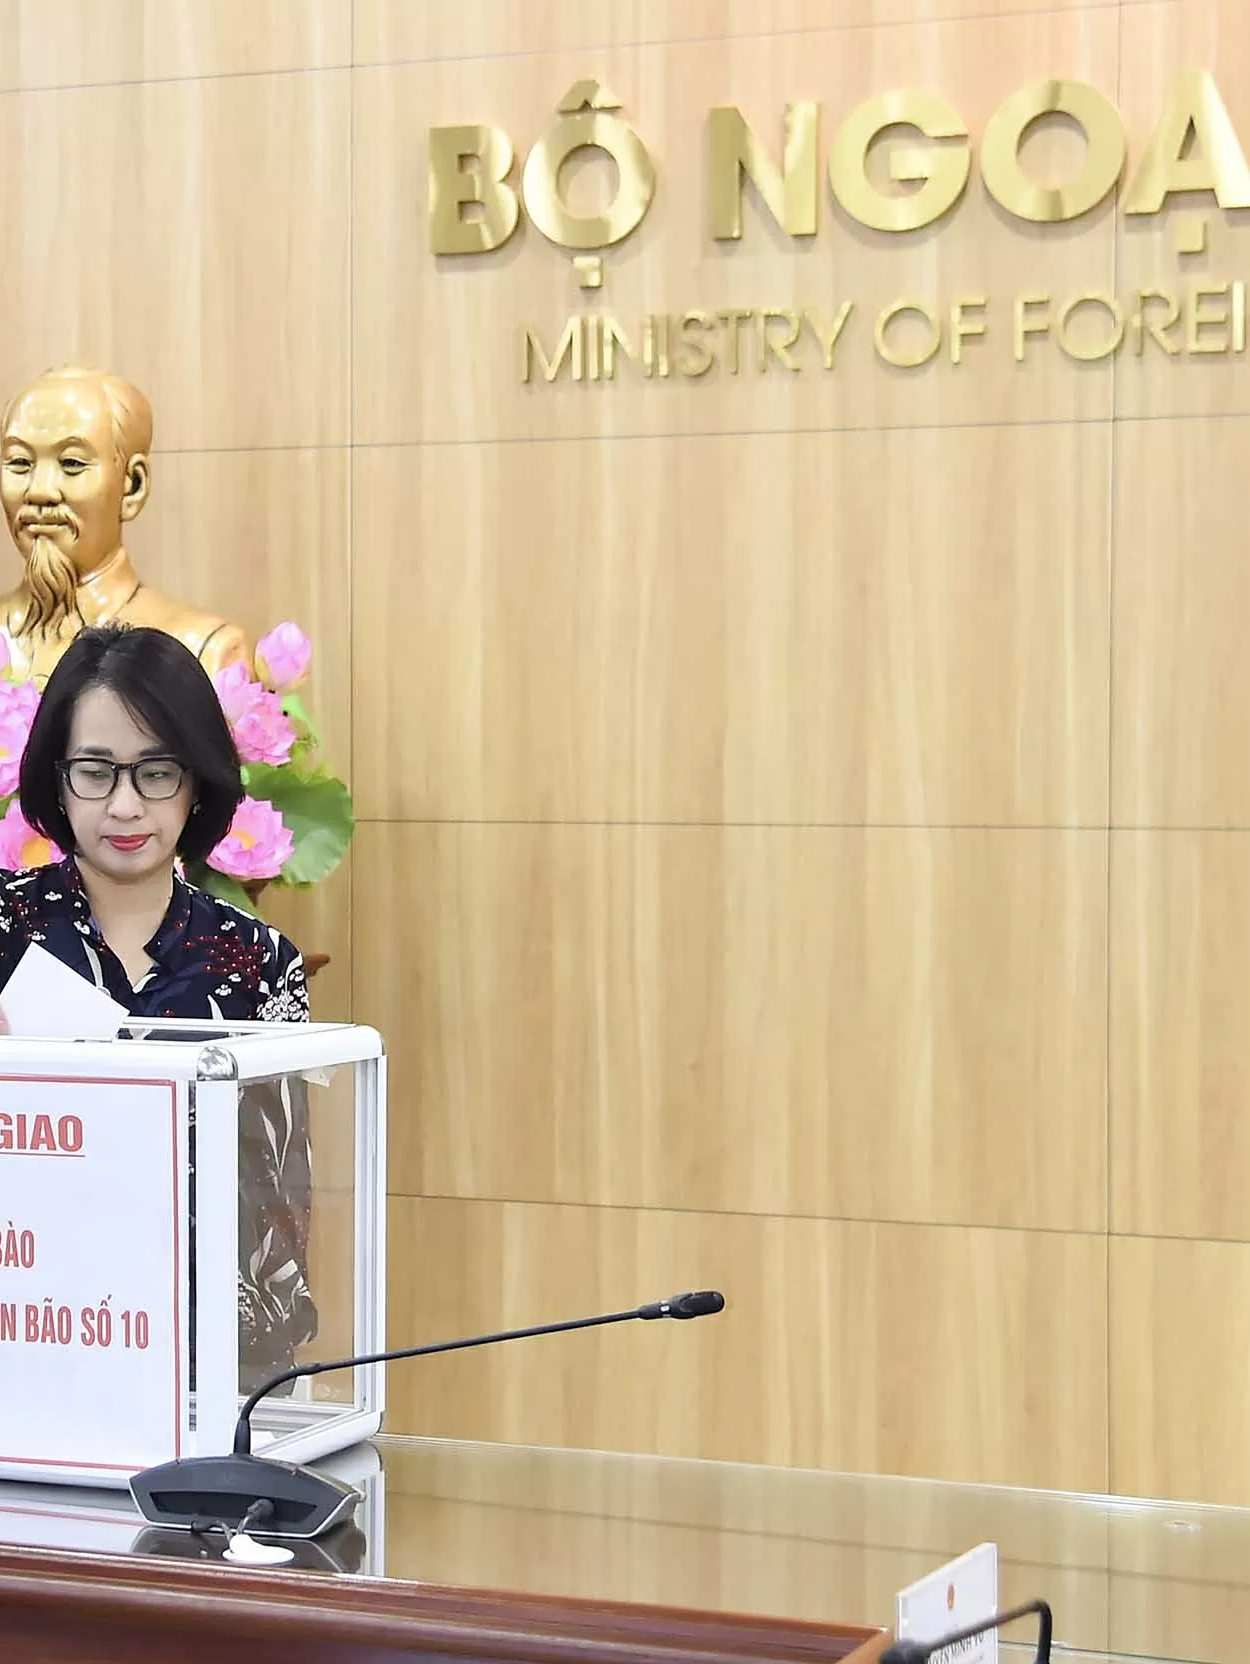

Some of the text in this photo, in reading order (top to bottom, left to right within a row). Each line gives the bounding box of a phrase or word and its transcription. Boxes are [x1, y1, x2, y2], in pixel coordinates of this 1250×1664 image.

[428, 69, 1250, 288] BỘ NGOẠ
[521, 280, 1247, 384] MINISTRY OF FOREI
[25, 1298, 72, 1347] BÃO
[80, 1294, 113, 1348] SỐ
[120, 1309, 150, 1350] 10
